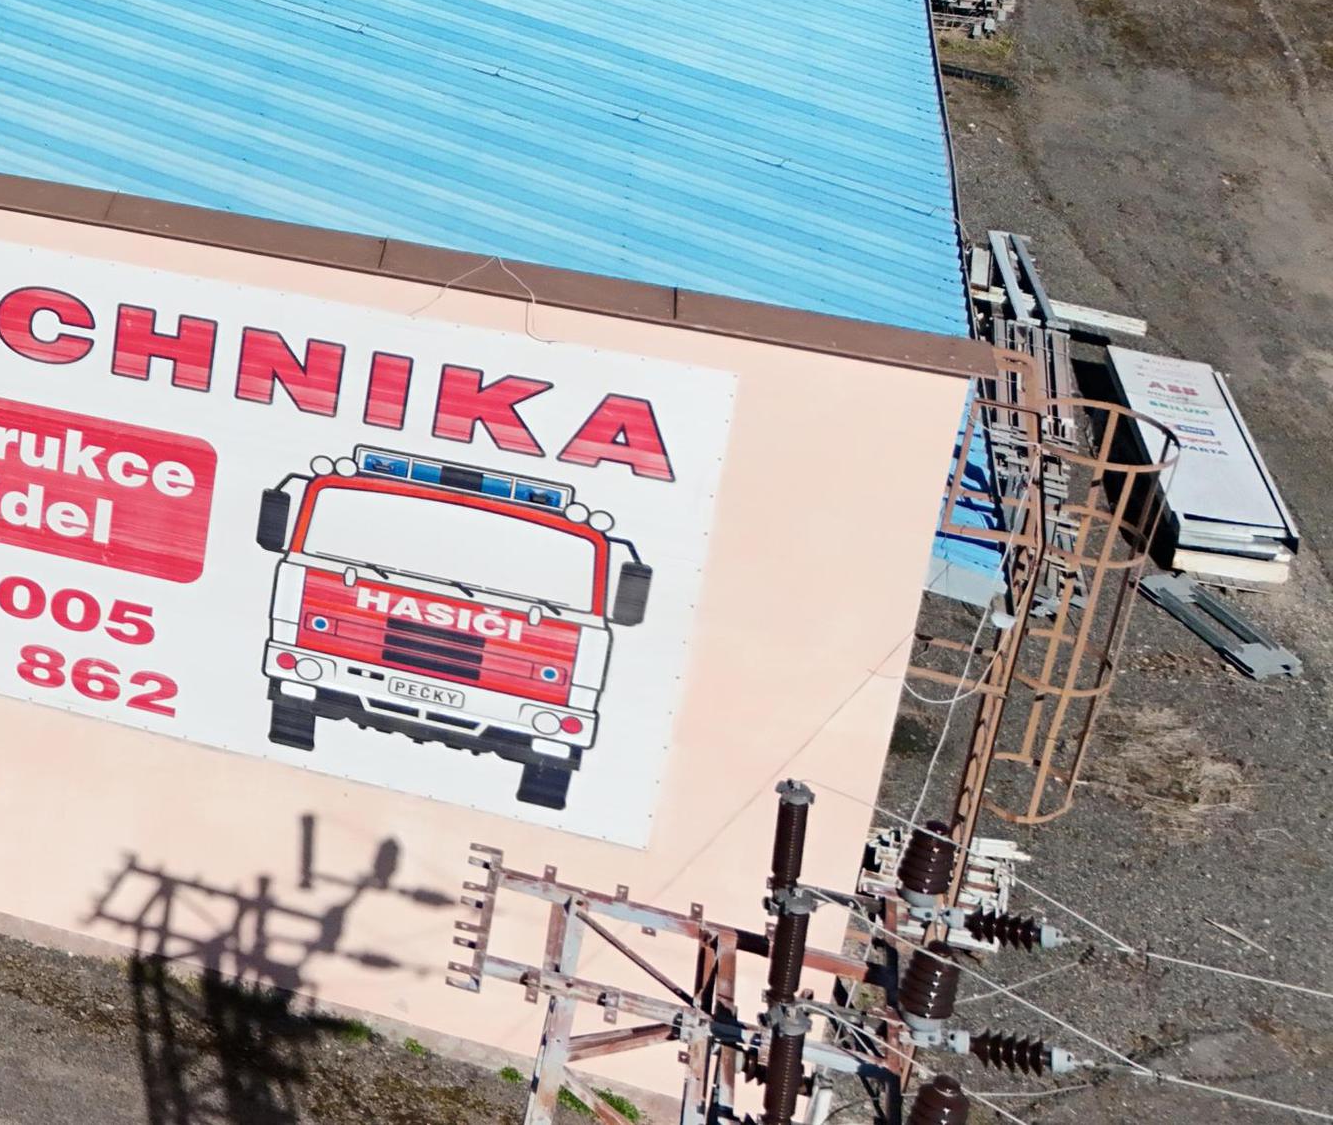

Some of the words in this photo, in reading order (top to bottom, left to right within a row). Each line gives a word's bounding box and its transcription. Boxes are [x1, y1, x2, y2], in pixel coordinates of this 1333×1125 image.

[356, 586, 524, 643] HASIČI
[15, 643, 180, 719] 862
[394, 681, 459, 706] PEČKY
